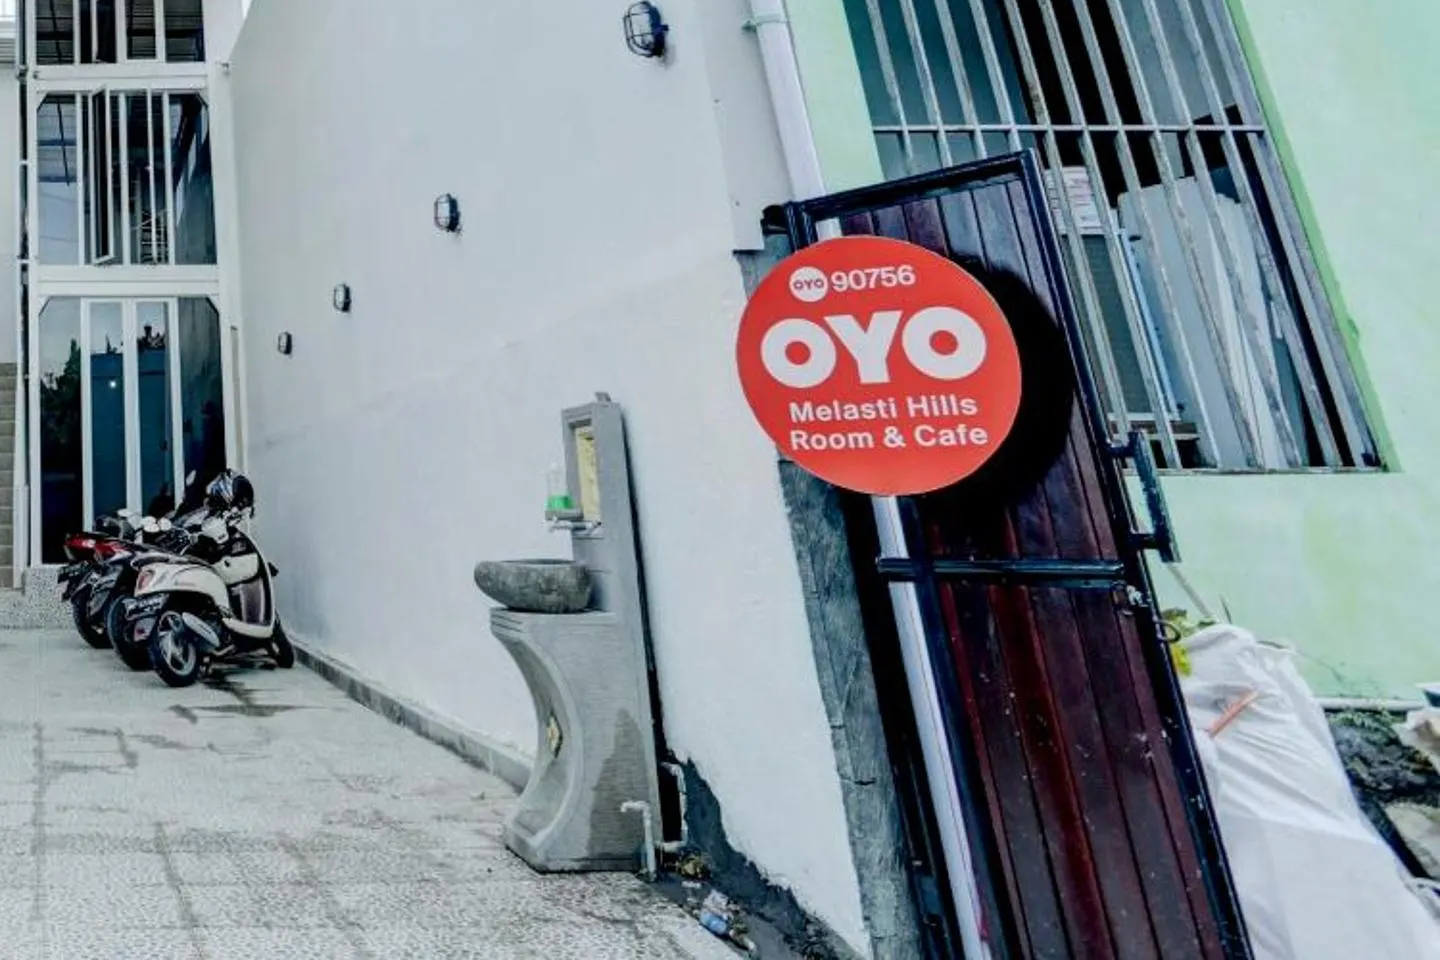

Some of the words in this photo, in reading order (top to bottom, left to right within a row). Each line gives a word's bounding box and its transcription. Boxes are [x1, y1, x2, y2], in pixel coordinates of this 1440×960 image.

[793, 278, 825, 290] OYO
[831, 265, 916, 292] 90756
[761, 306, 987, 388] OYO
[789, 397, 898, 423] Melasti
[907, 394, 978, 418] Hills
[790, 430, 875, 451] Room
[883, 426, 906, 448] &
[914, 424, 988, 447] Cafe
